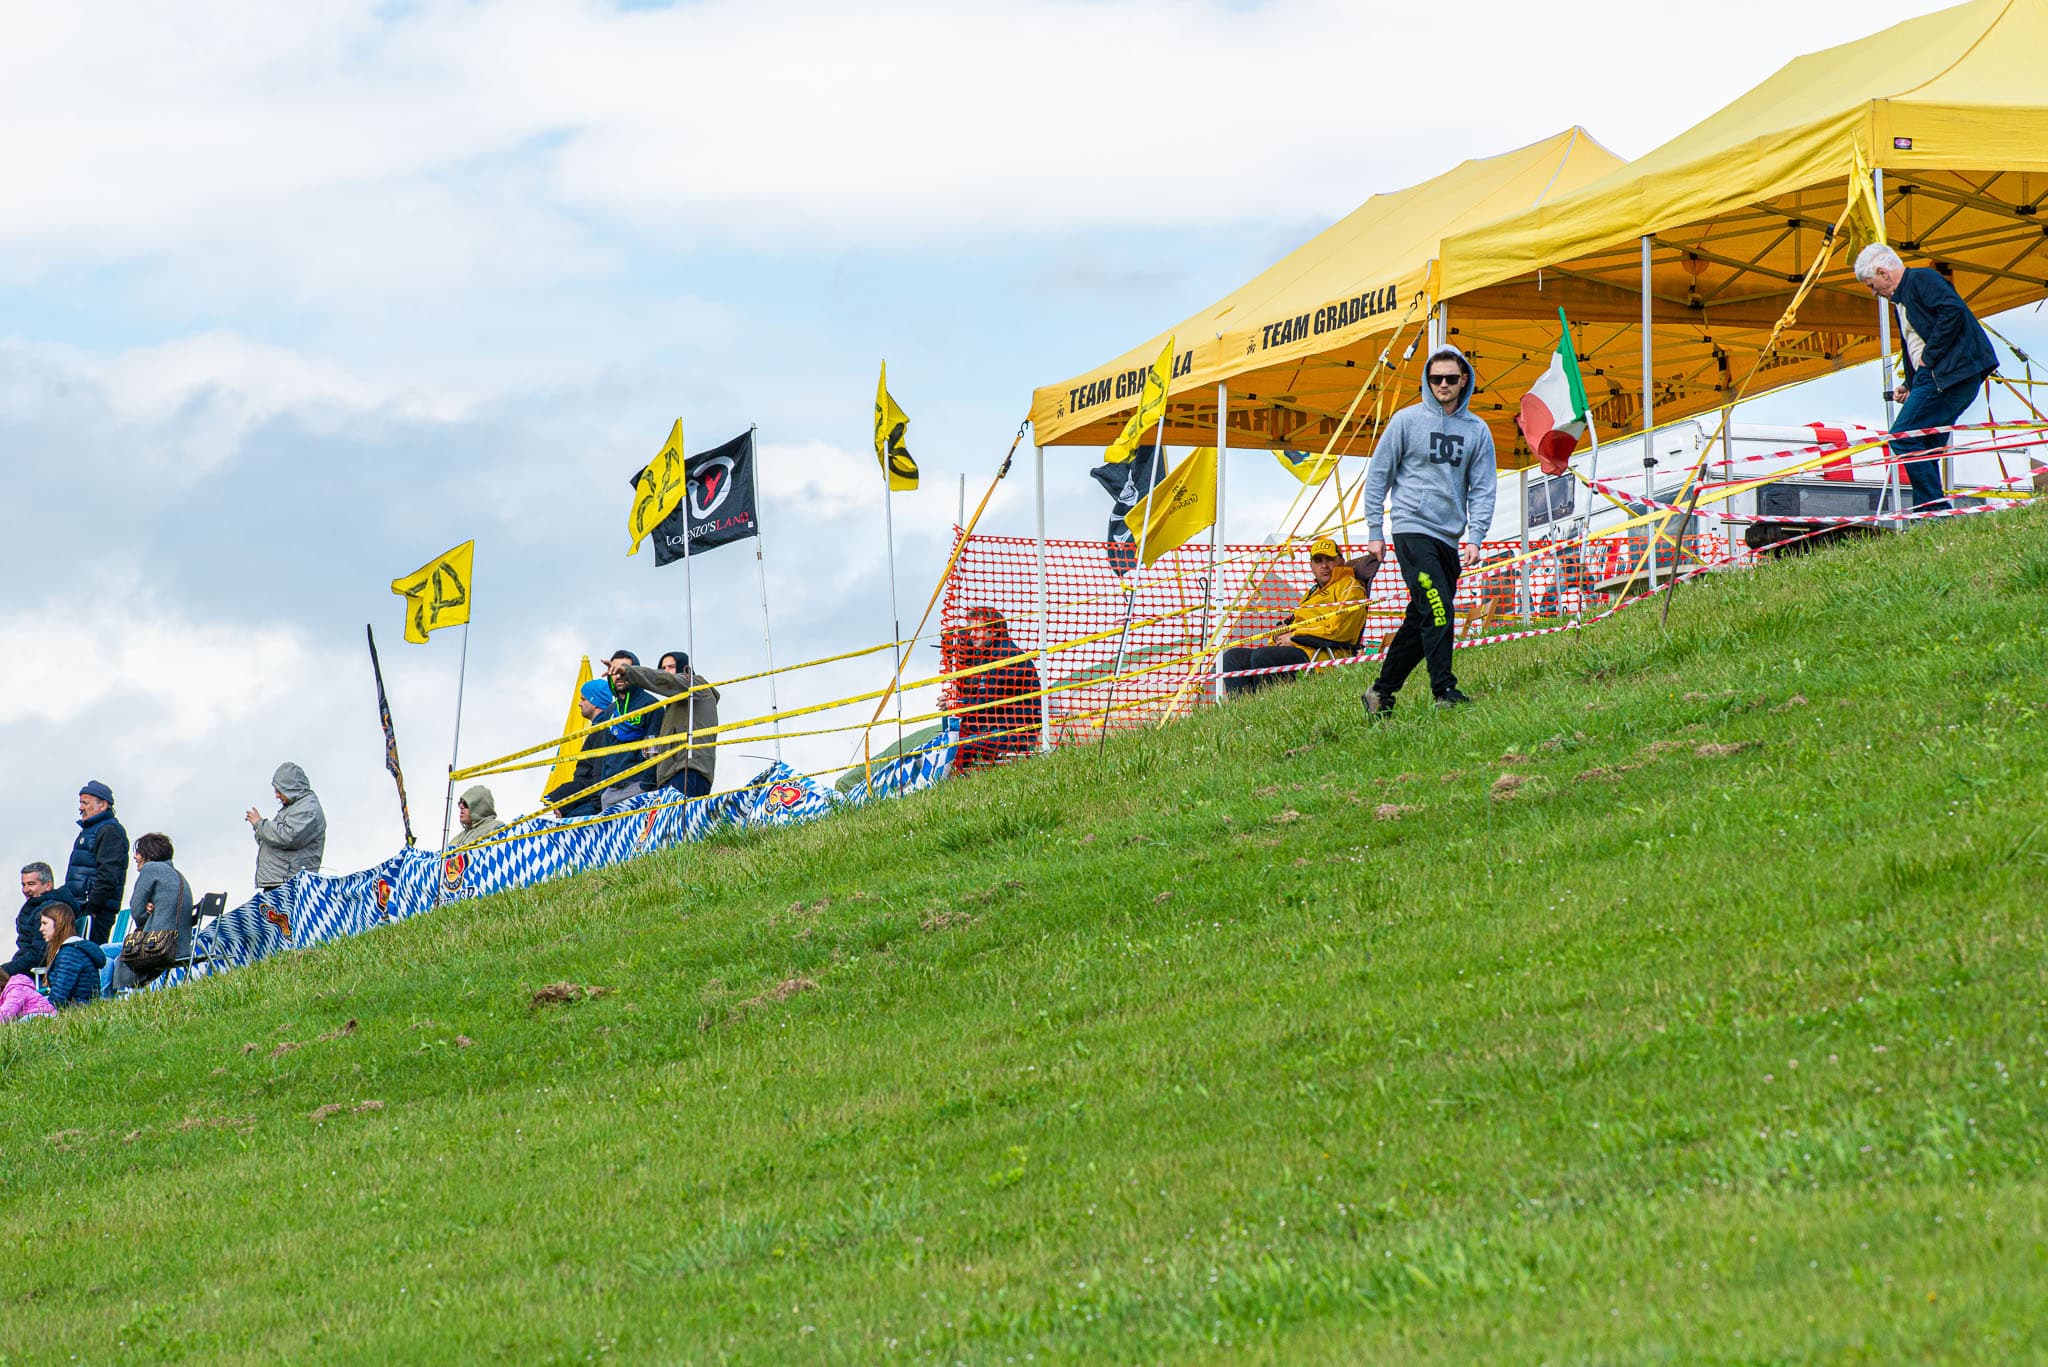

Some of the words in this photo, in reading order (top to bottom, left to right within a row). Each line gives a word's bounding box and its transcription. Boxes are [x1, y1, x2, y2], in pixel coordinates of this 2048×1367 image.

[1262, 313, 1311, 350] TEAM
[1313, 284, 1398, 336] GRADELLA
[1069, 377, 1113, 413] TEAM
[1115, 350, 1194, 399] GRALA
[1429, 431, 1465, 467] DC
